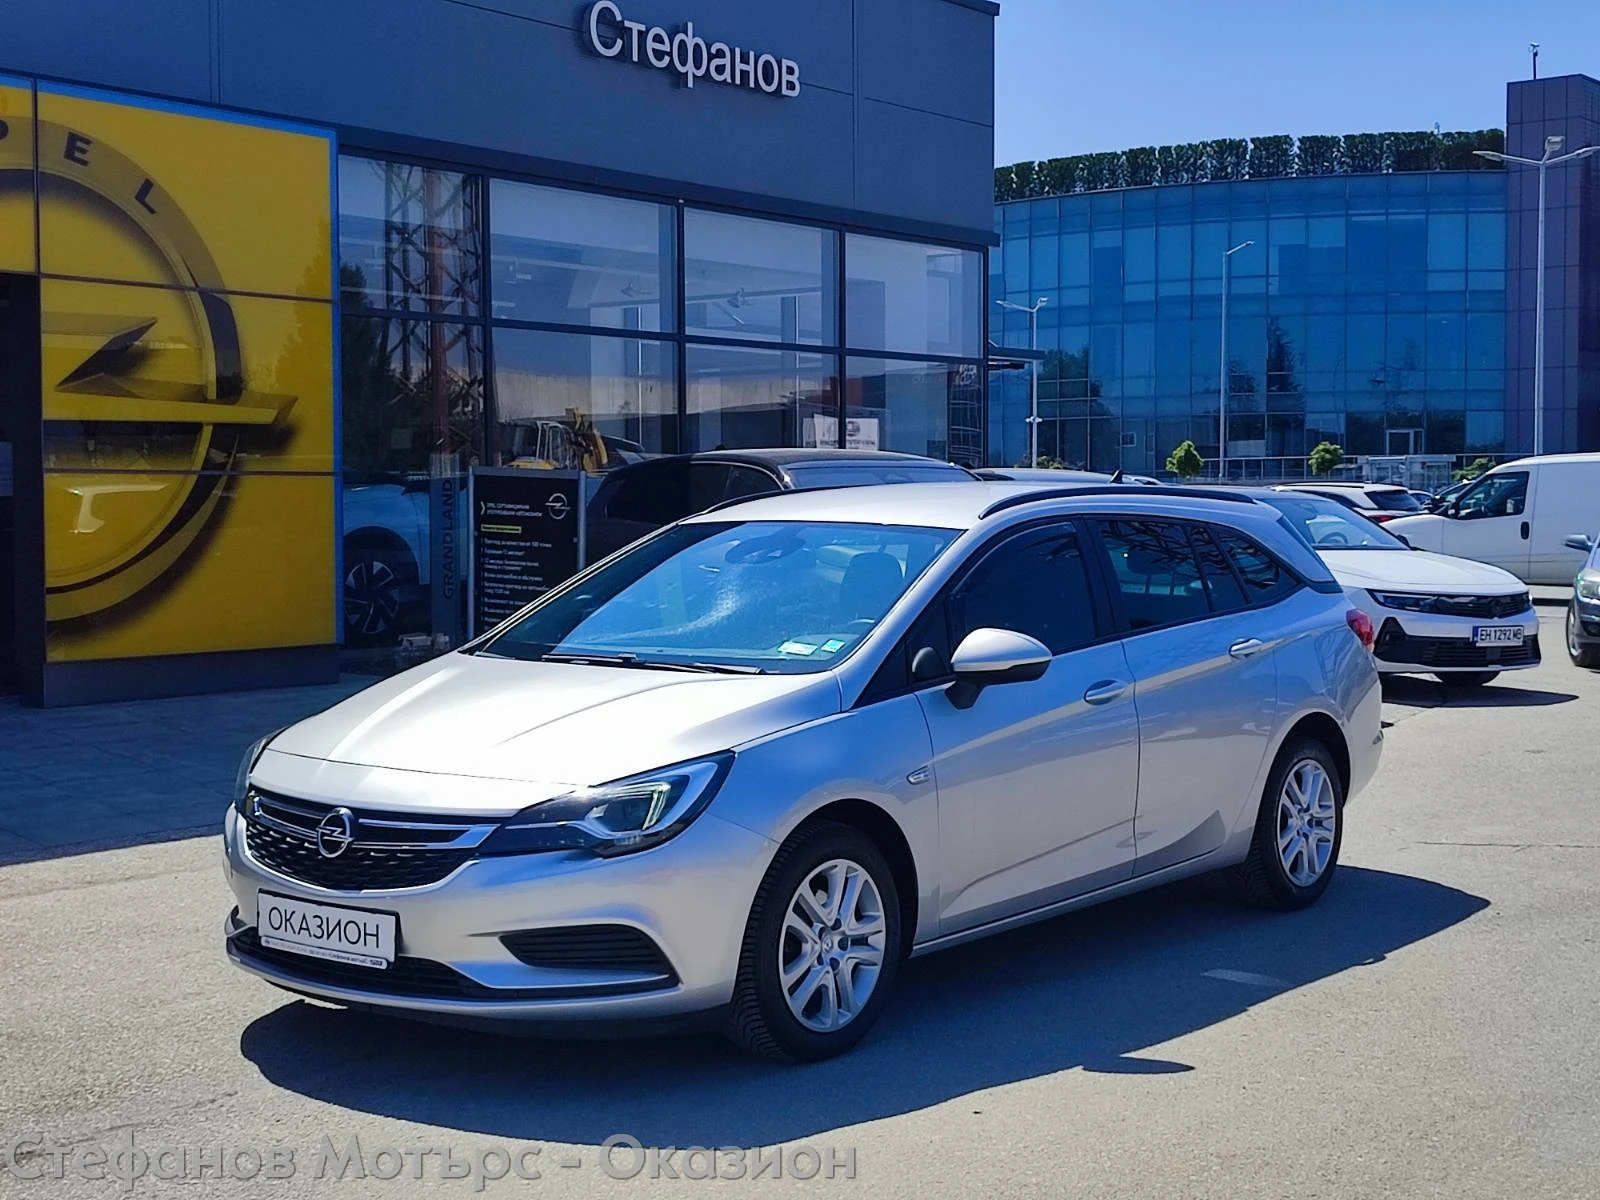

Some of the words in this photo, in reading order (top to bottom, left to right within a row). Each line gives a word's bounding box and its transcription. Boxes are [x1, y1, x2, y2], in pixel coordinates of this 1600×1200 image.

[589, 0, 801, 98] Стефанов
[442, 479, 454, 600] GRANDLAND
[1480, 629, 1491, 641] EH
[1494, 628, 1512, 641] 1292
[268, 906, 380, 949] ОКАЗИОН
